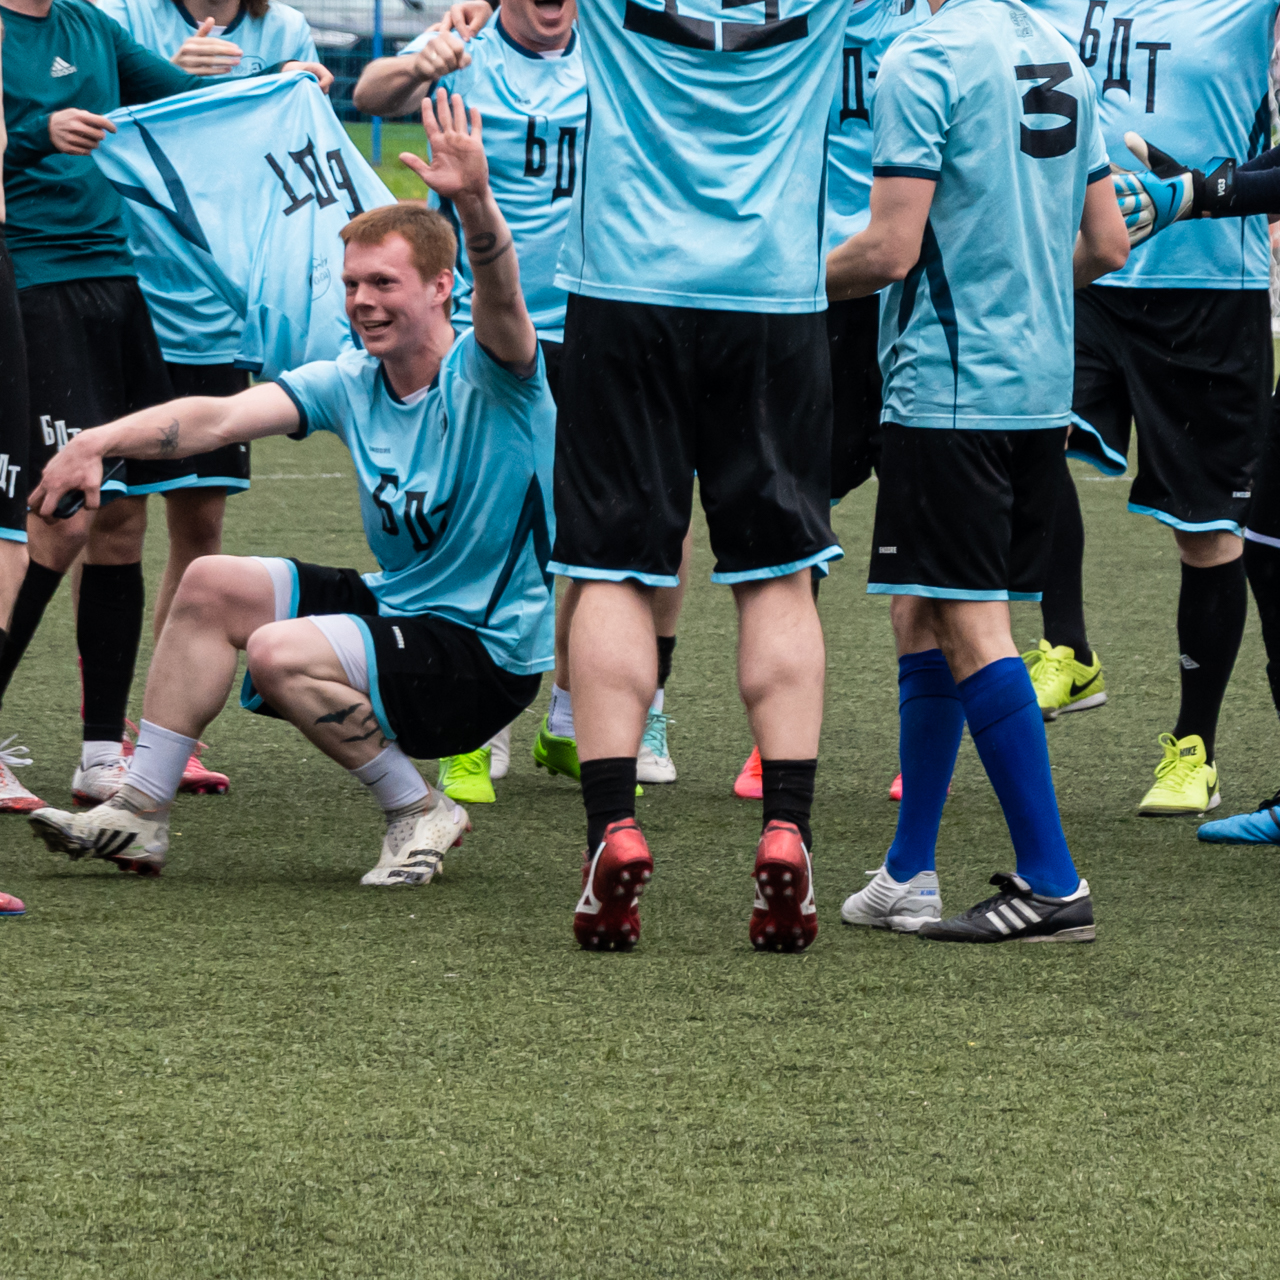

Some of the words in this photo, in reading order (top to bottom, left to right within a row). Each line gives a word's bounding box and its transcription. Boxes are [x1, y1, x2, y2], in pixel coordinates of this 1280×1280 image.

[1079, 0, 1172, 114] БДТ
[1013, 61, 1078, 159] 3
[523, 115, 578, 208] БД
